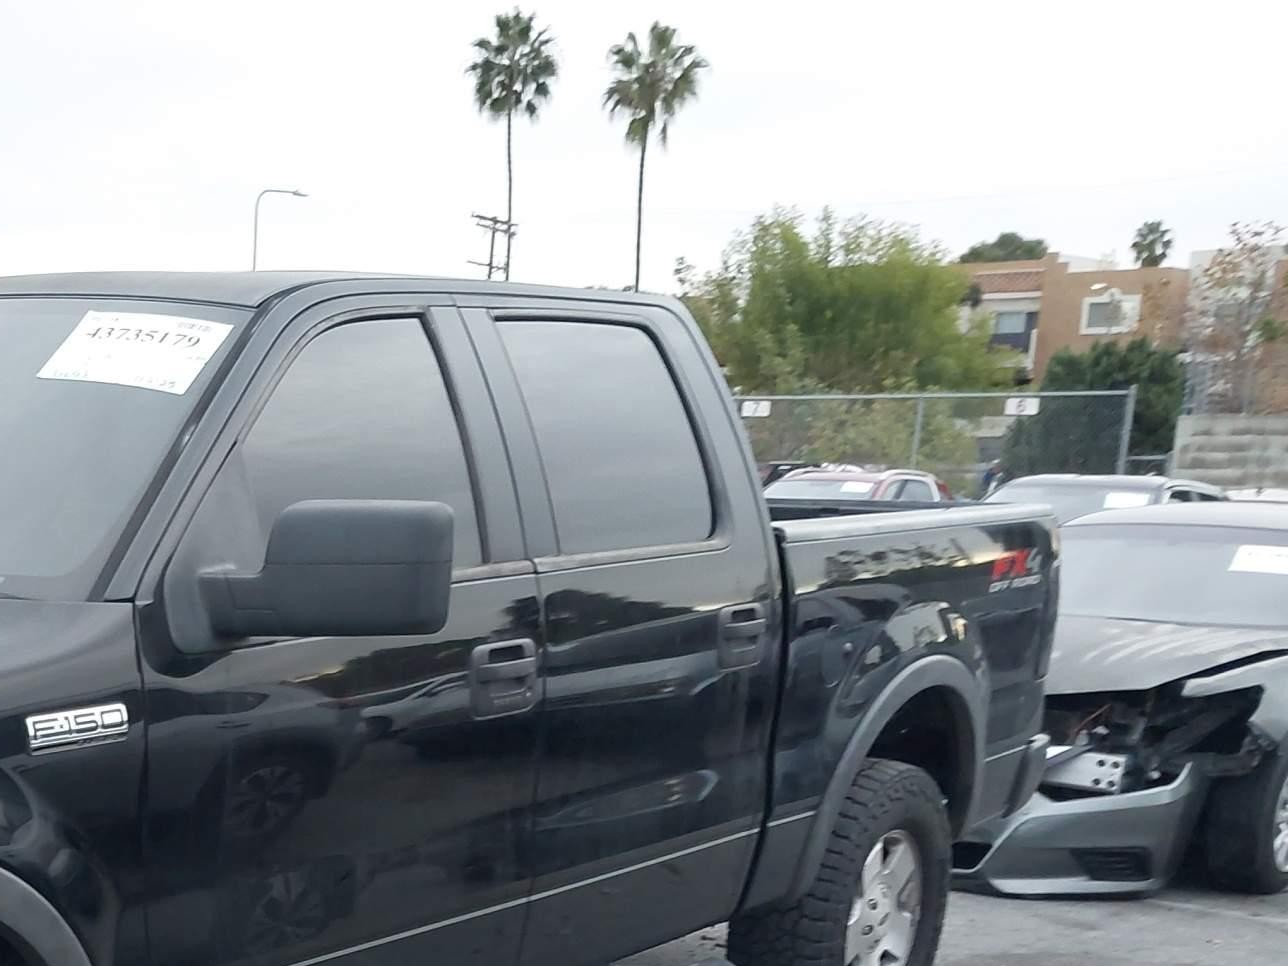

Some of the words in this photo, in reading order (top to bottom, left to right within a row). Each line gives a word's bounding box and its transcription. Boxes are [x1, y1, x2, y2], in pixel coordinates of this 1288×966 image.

[86, 326, 201, 349] 43735179
[990, 547, 1043, 581] FX4
[32, 708, 125, 741] F-150
